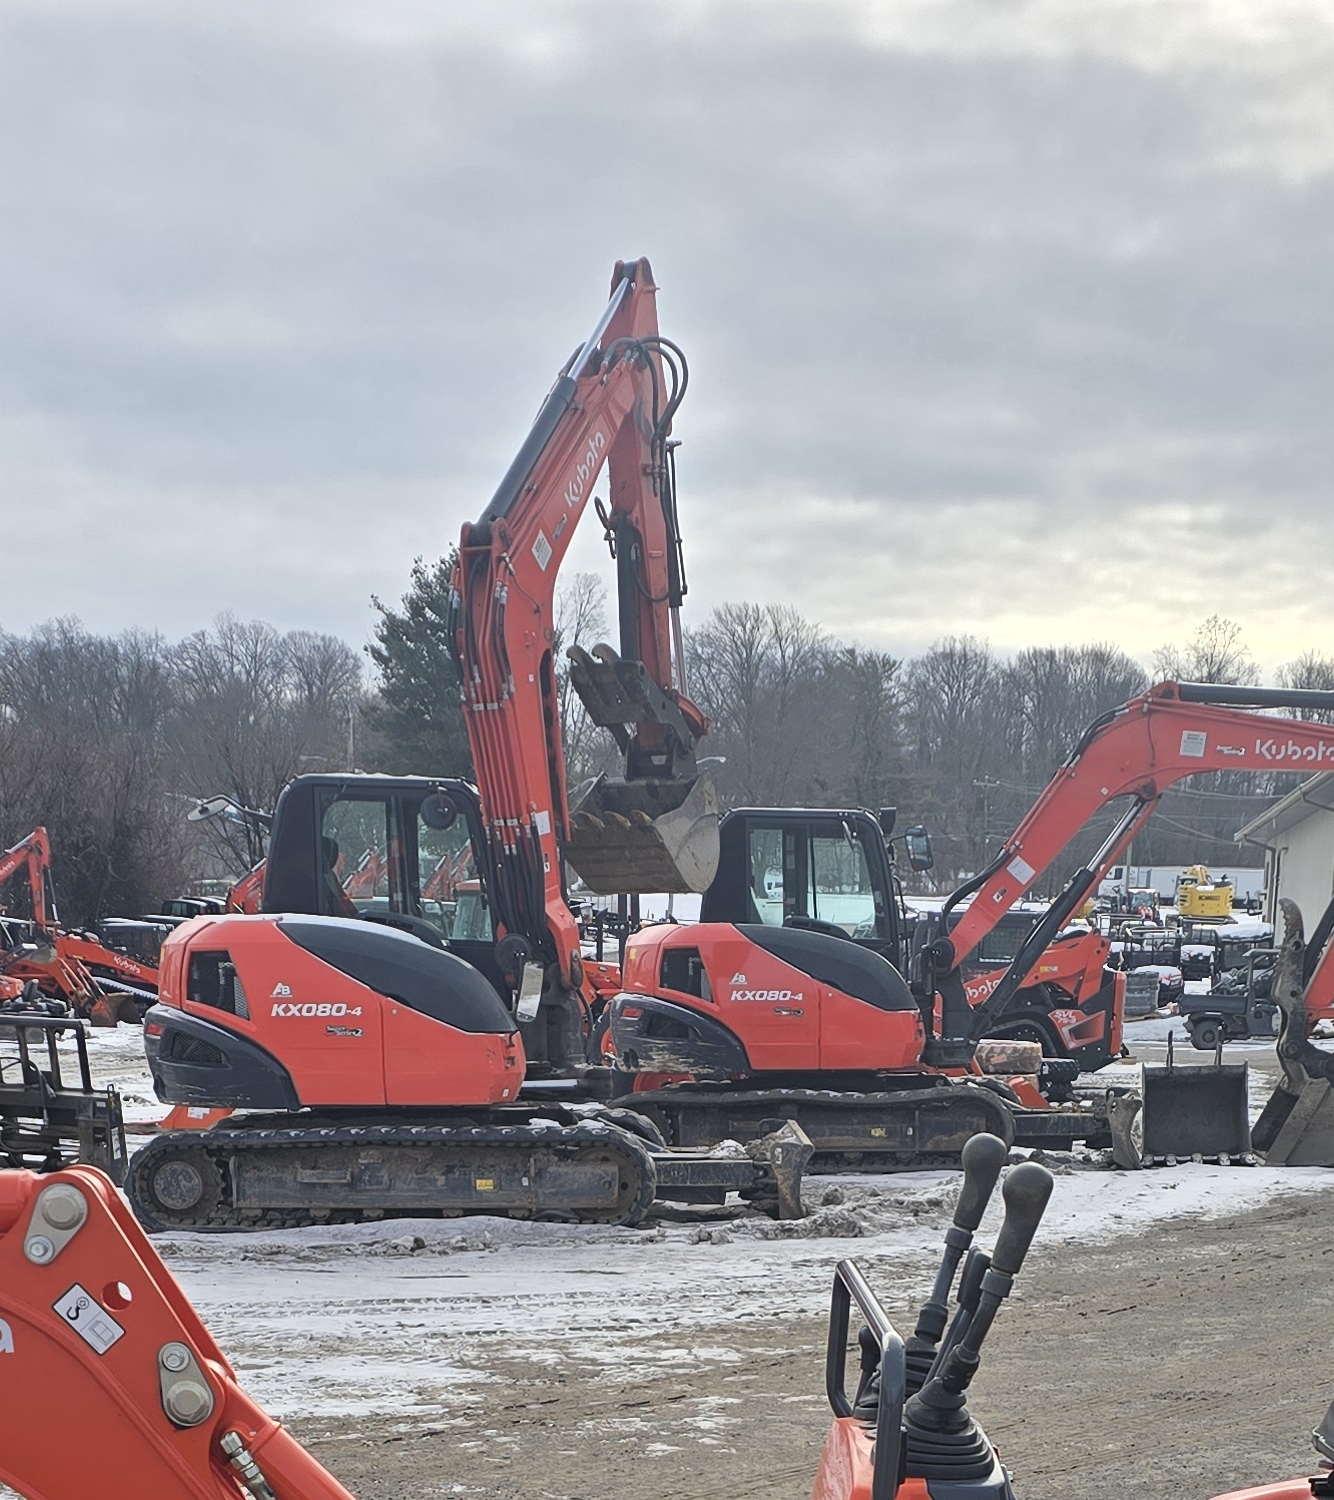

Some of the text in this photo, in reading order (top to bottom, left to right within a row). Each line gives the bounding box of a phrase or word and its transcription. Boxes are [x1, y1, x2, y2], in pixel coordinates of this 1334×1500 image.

[564, 431, 605, 508] Kubota
[114, 956, 140, 974] Kubota
[730, 990, 803, 1001] KX080-4
[270, 1003, 362, 1016] KX080-4
